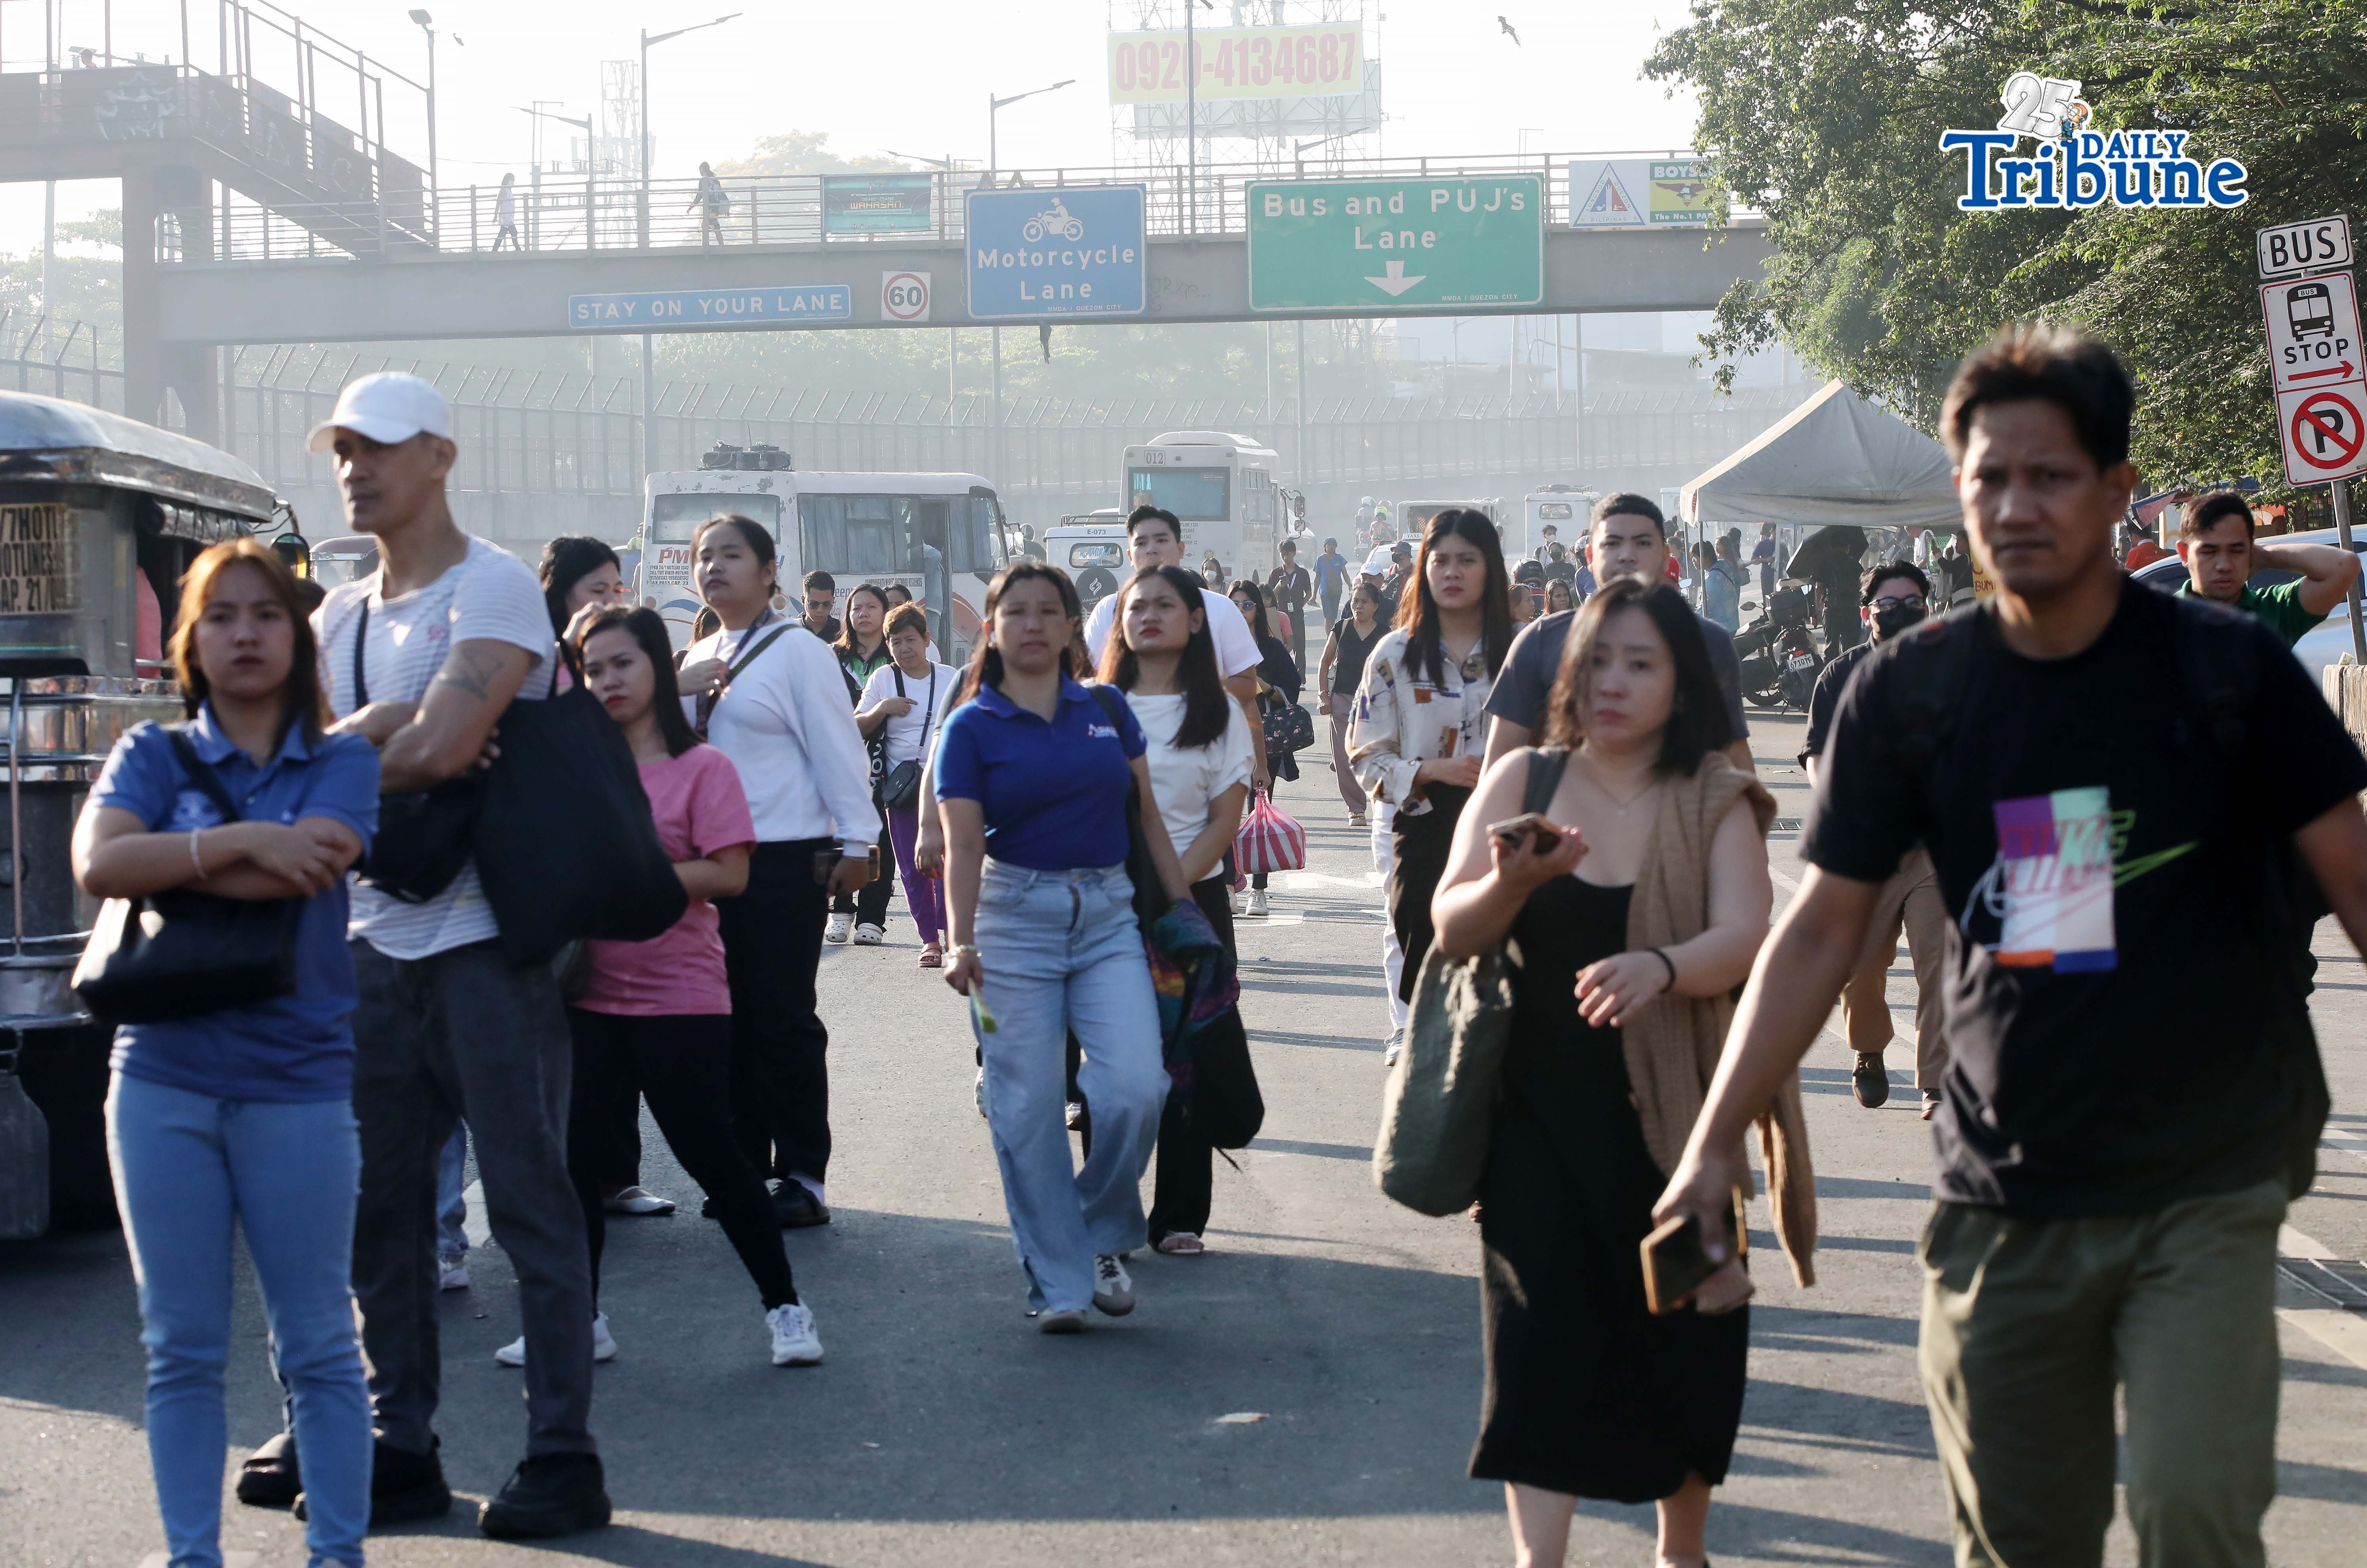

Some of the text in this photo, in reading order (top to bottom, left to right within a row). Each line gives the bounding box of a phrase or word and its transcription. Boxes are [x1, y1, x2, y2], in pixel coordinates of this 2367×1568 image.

[1115, 32, 1356, 91] 0920-4134687
[1264, 187, 1525, 217] Bus and PUJ's
[1585, 180, 1631, 211] LUNGSOD QUEZON
[1355, 226, 1437, 249] Lane
[2269, 226, 2336, 267] BUS
[978, 245, 1134, 270] Motorcycle
[889, 286, 922, 306] 60
[1021, 281, 1092, 300] Lane
[578, 293, 843, 320] STAY ON YOUR LANE
[2284, 338, 2349, 364] STOP
[1146, 453, 1164, 464] 012
